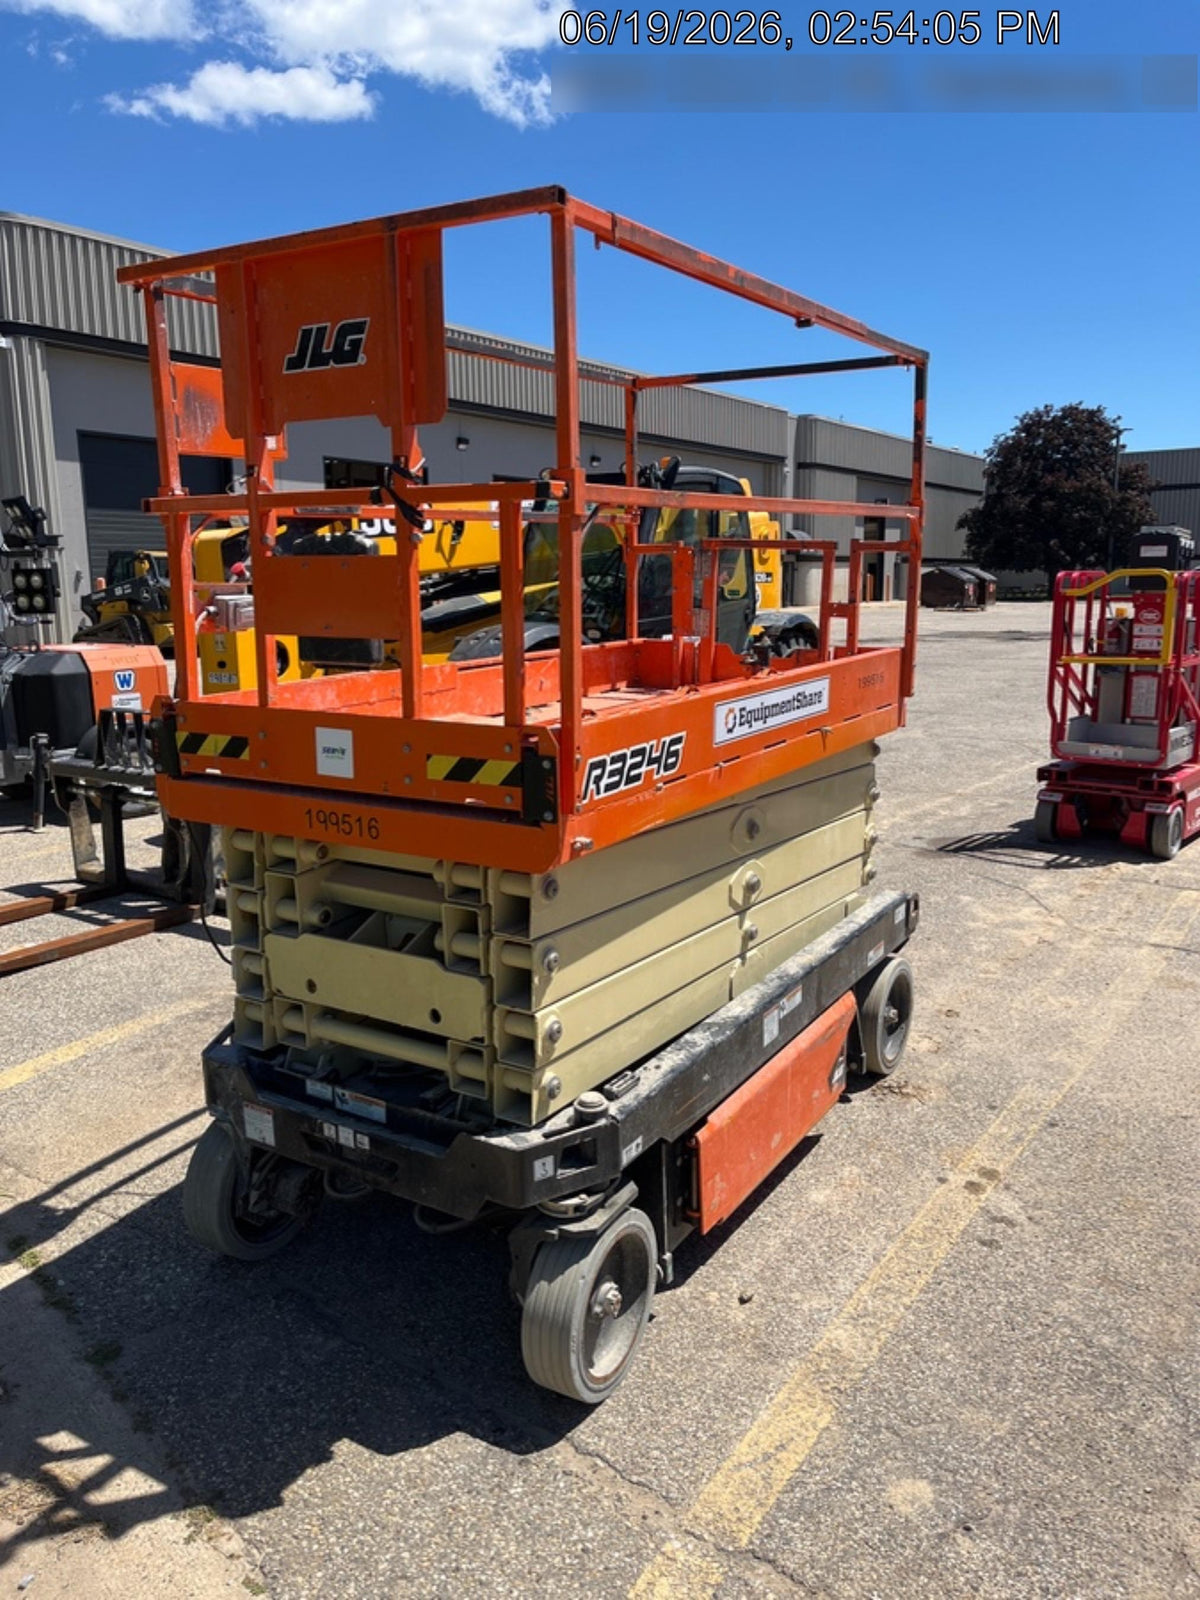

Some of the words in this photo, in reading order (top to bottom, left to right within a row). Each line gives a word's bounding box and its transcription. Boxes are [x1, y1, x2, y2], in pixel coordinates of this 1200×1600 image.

[283, 317, 370, 374] JLG
[738, 691, 823, 728] EquipmentShare
[582, 730, 687, 805] R3246
[305, 808, 380, 840] 199516
